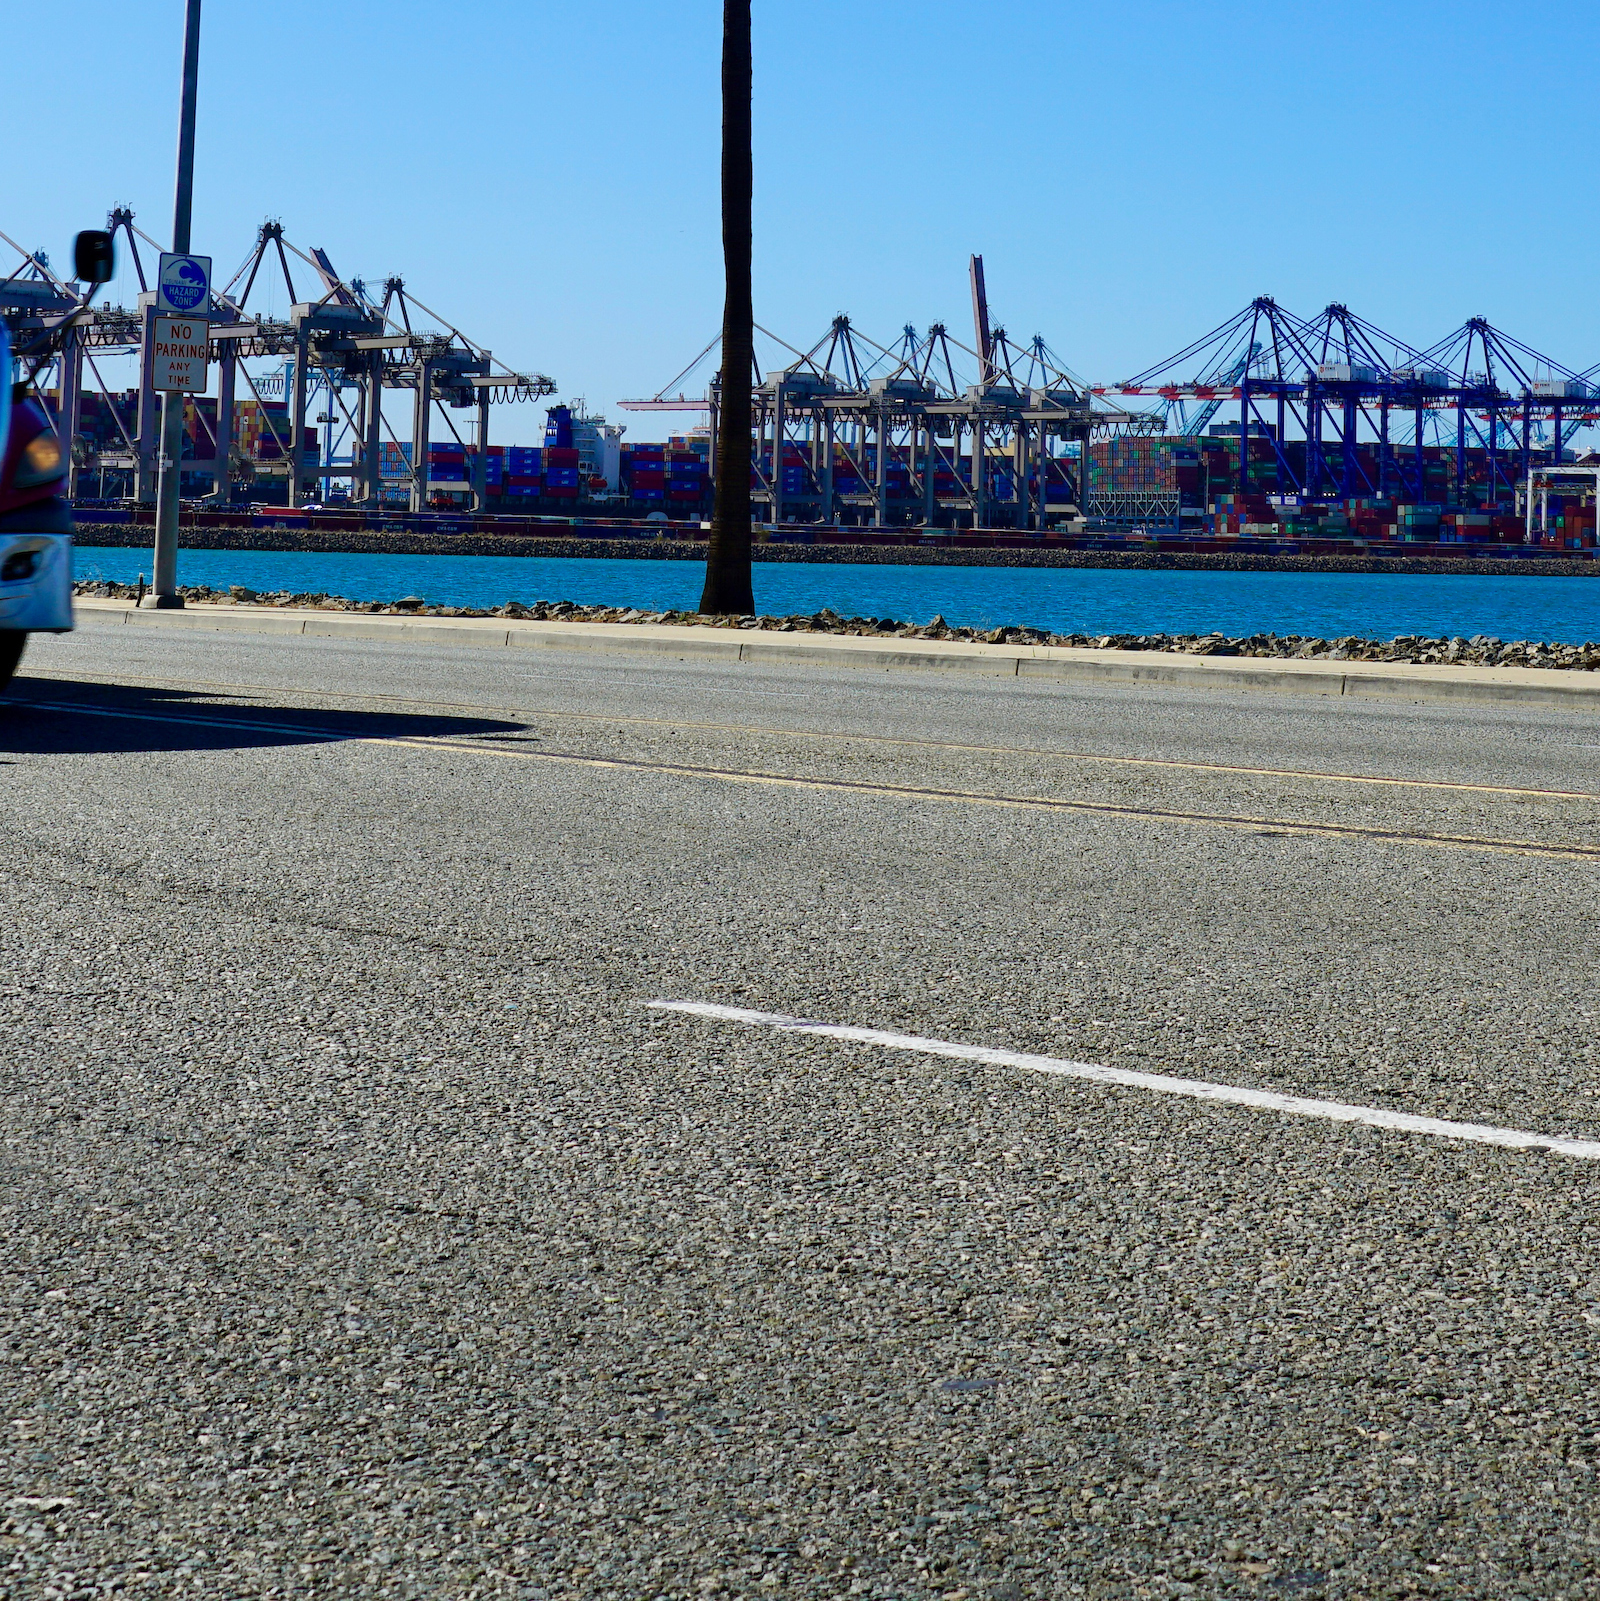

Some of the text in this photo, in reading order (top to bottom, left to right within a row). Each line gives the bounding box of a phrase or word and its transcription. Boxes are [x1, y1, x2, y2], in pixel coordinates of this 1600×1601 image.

[169, 286, 199, 297] HAZARD
[173, 296, 193, 306] ZONE
[171, 325, 192, 339] NO
[156, 343, 205, 359] PARKING
[169, 361, 191, 371] ANY
[168, 375, 191, 385] TIME
